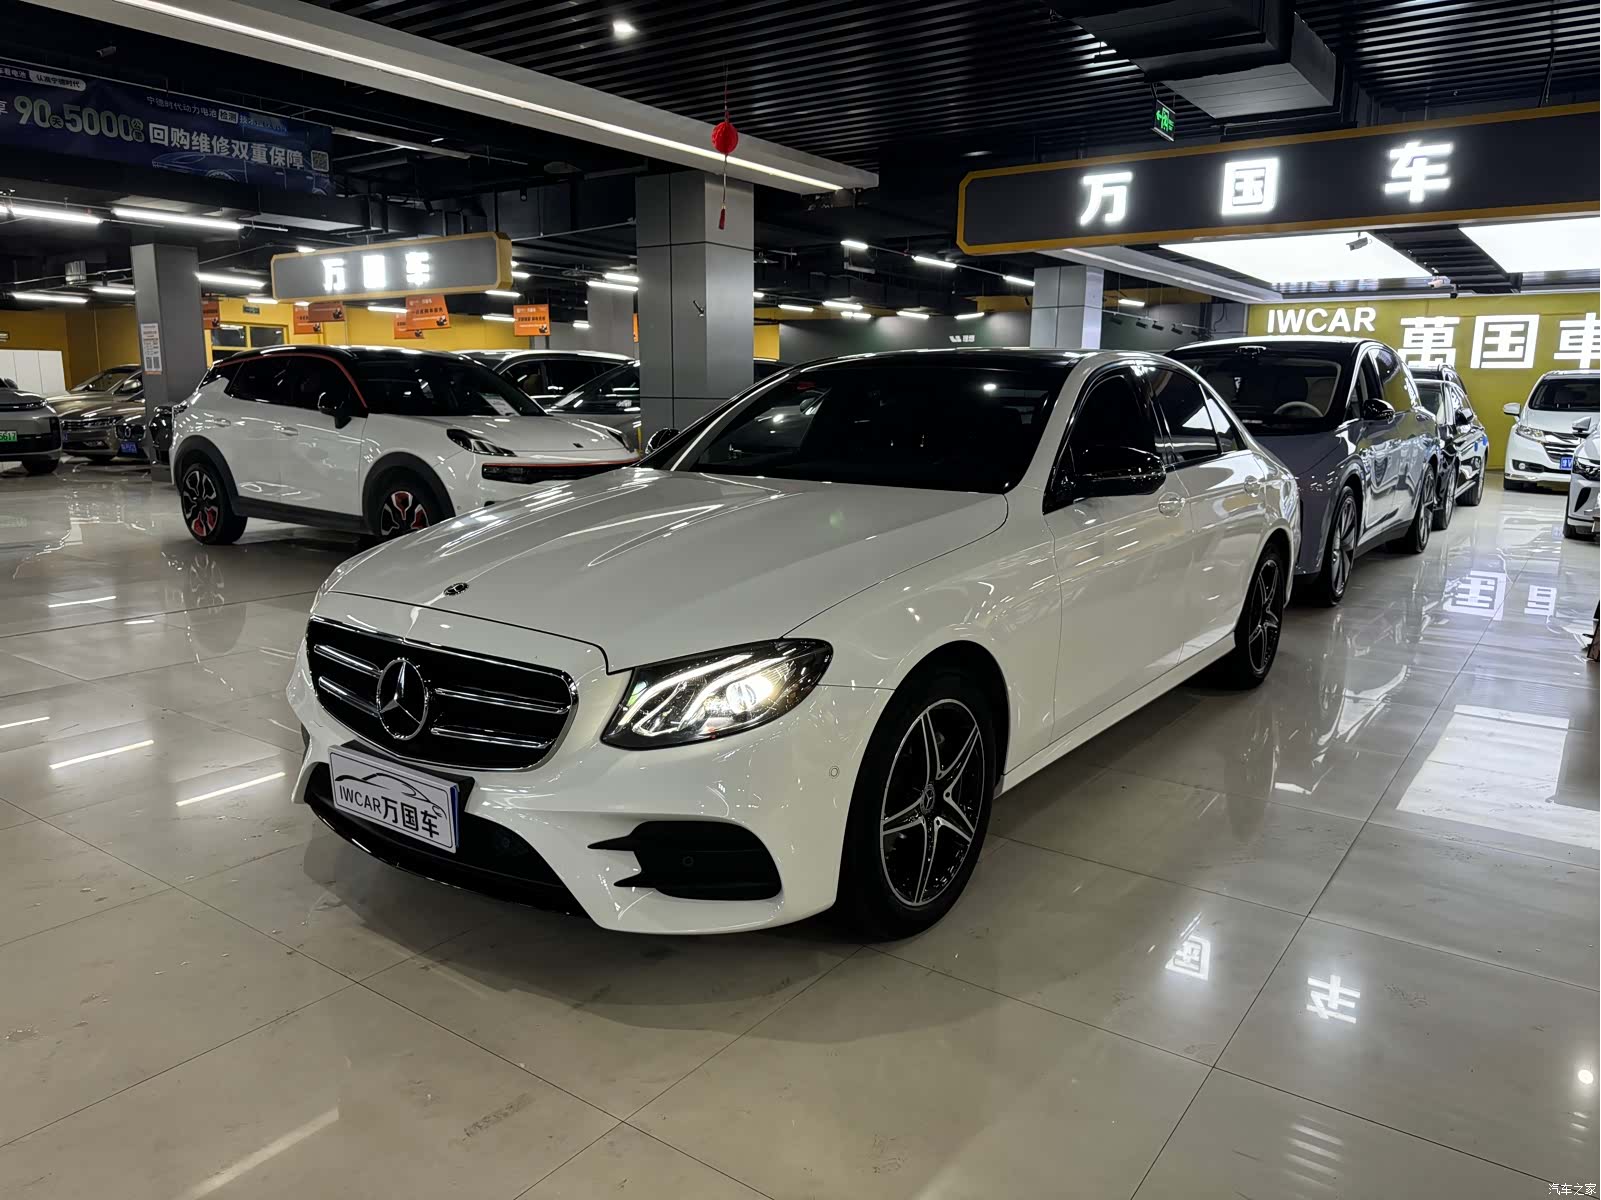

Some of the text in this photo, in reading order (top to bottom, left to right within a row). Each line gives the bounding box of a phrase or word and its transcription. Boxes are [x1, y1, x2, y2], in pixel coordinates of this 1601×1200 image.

[149, 123, 304, 170] 回购维修双重保障
[1080, 142, 1454, 226] 万国车
[1267, 306, 1377, 333] IWCAR
[339, 784, 440, 838] IWCAR万国车
